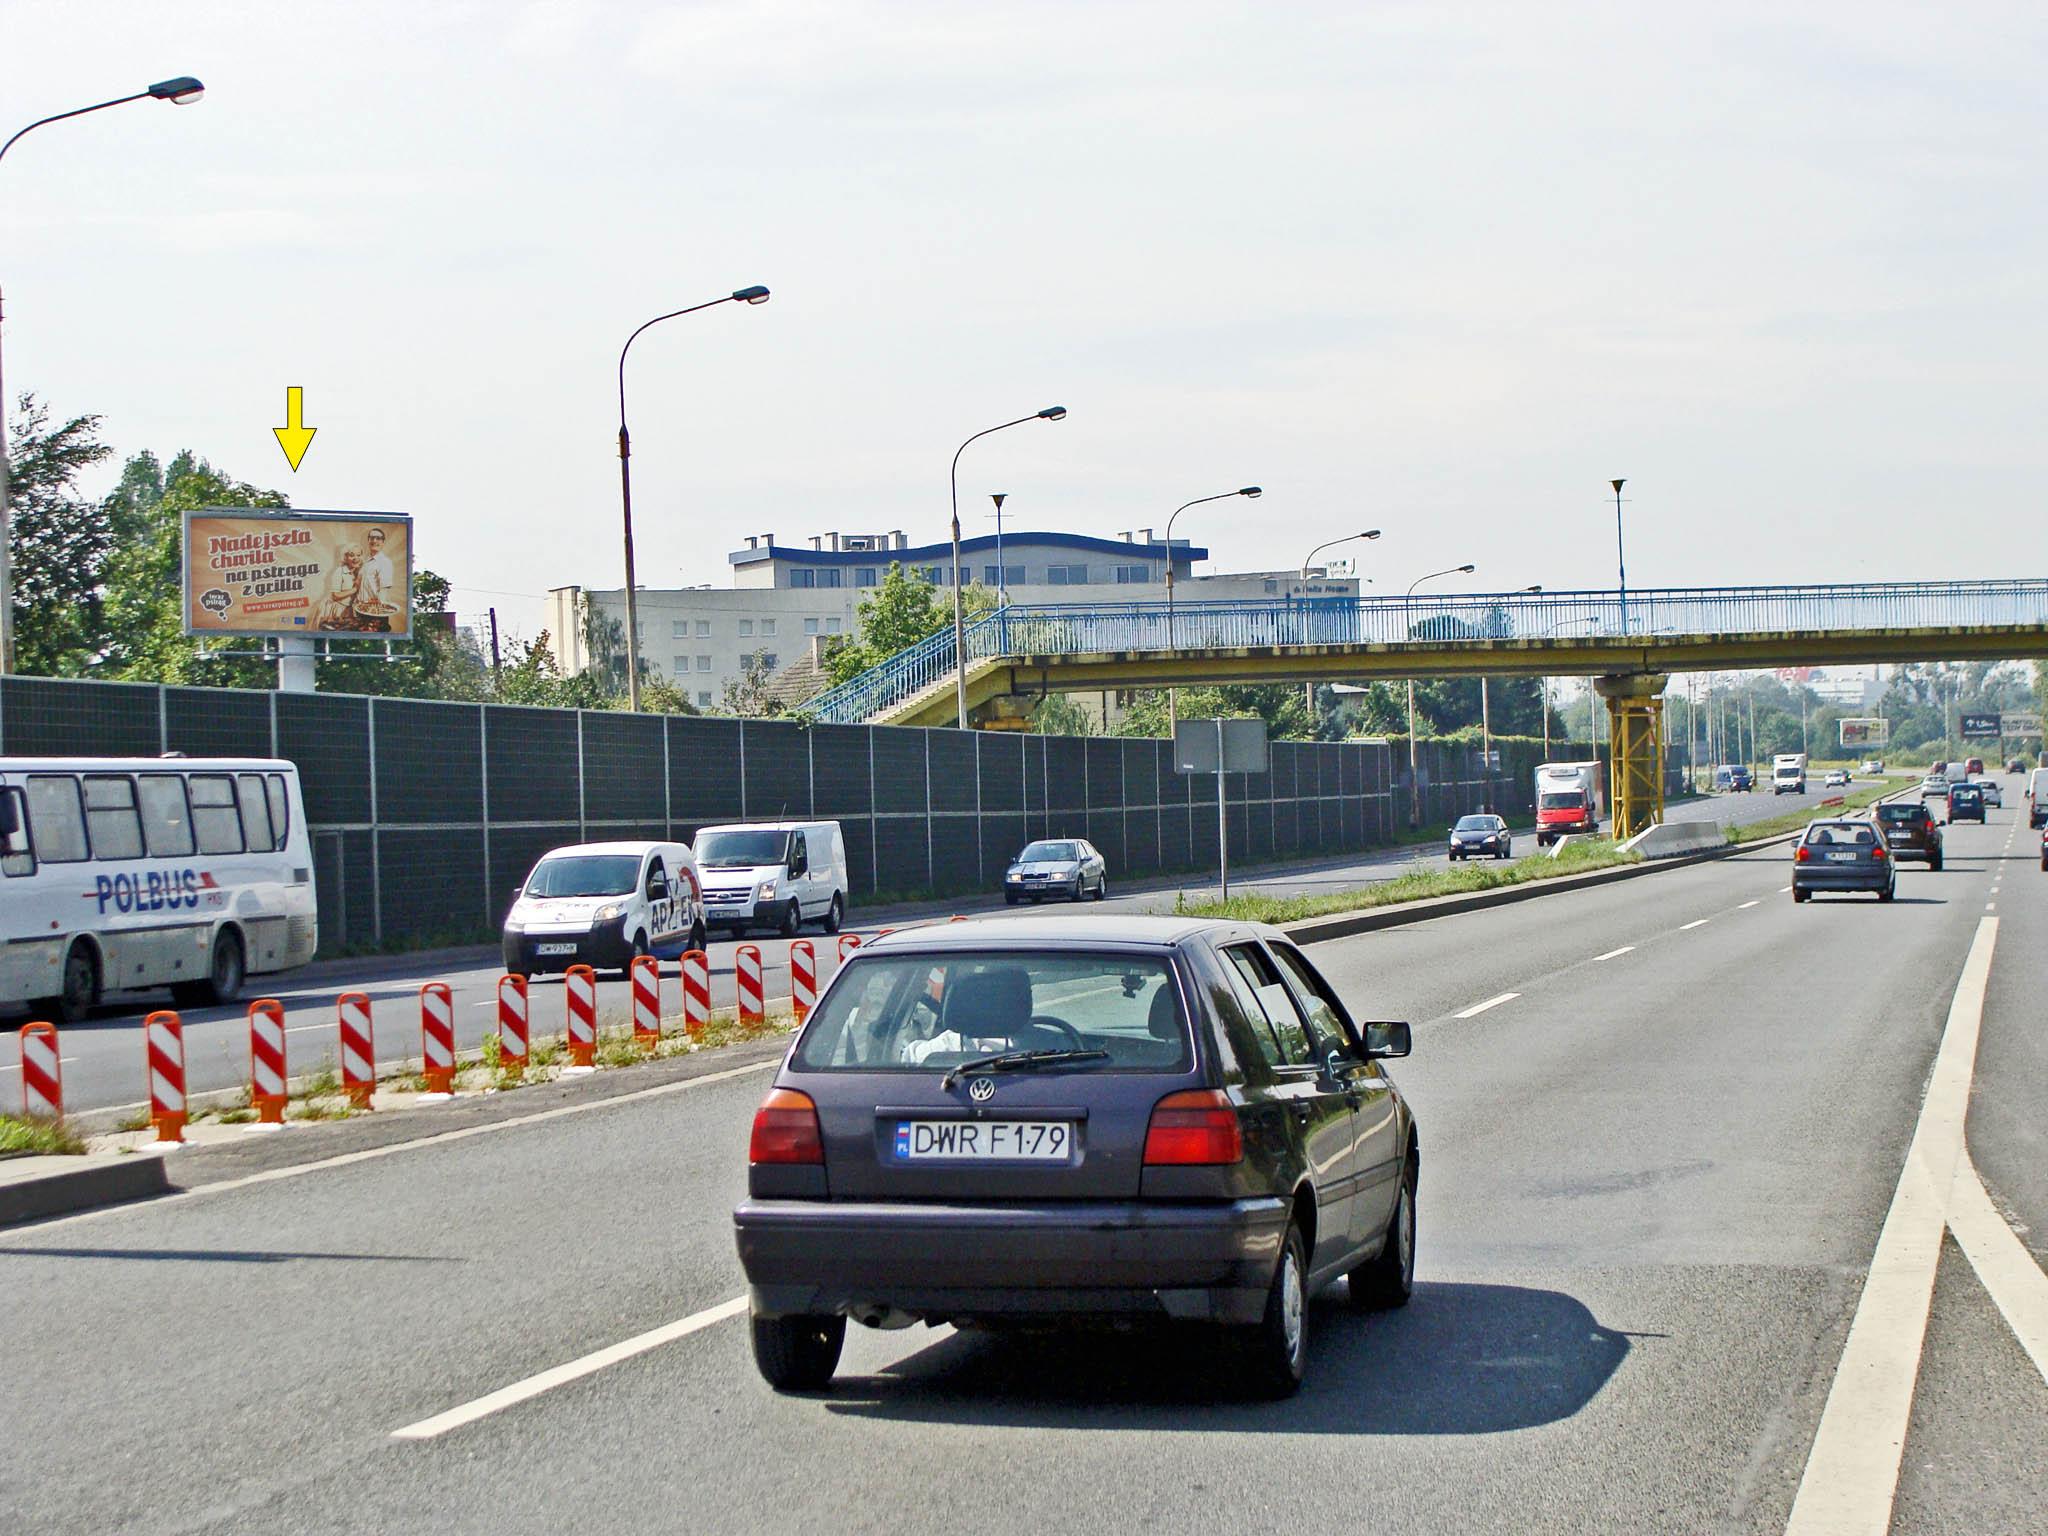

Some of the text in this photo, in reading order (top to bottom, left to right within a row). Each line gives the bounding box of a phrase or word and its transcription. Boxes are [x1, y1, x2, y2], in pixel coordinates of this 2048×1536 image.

[211, 551, 275, 569] chwila
[225, 571, 249, 583] na
[242, 578, 304, 597] z grilla
[96, 869, 199, 914] POLBUS
[915, 1125, 979, 1154] DWR
